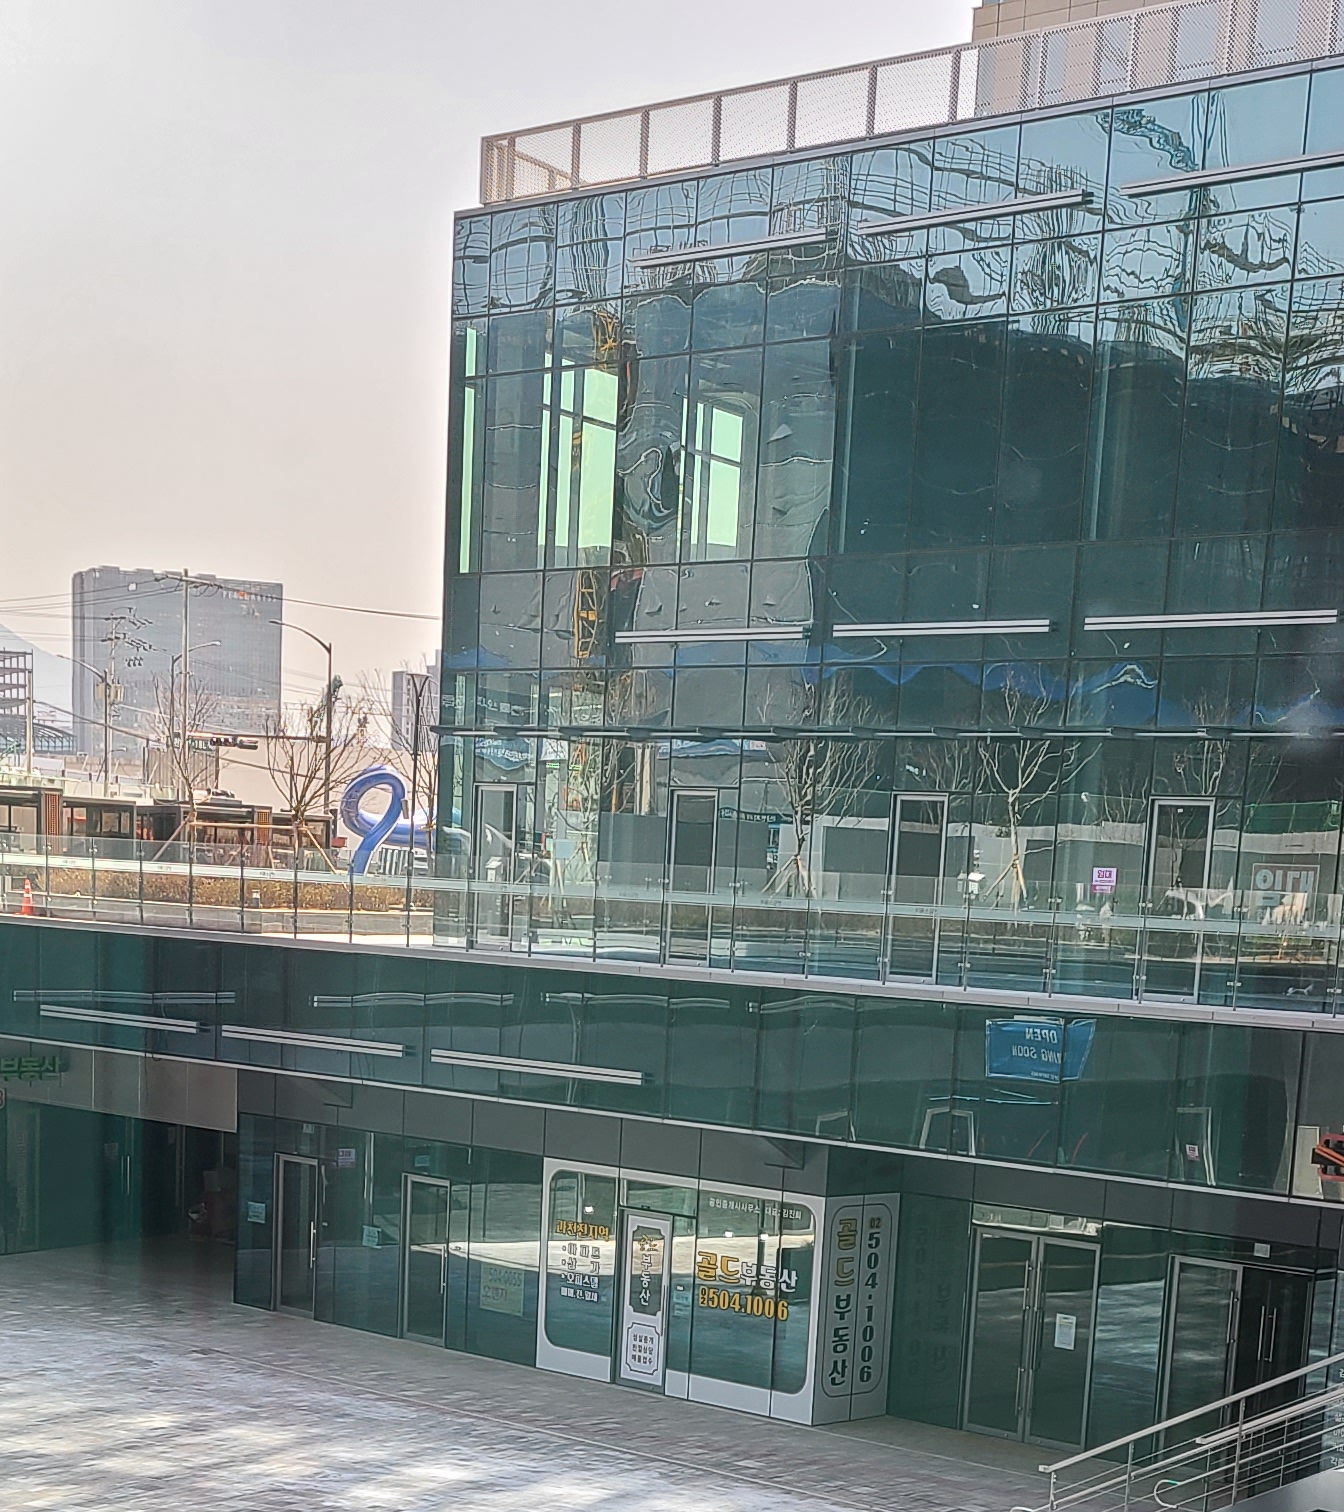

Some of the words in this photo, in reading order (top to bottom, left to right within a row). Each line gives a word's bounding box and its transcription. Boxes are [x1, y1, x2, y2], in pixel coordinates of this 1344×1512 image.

[868, 1217, 882, 1229] 02
[566, 1272, 599, 1289] 오피스텔
[639, 1253, 653, 1306] 부동산
[696, 1251, 799, 1294] 골드부동산
[828, 1218, 858, 1387] 골드부동산
